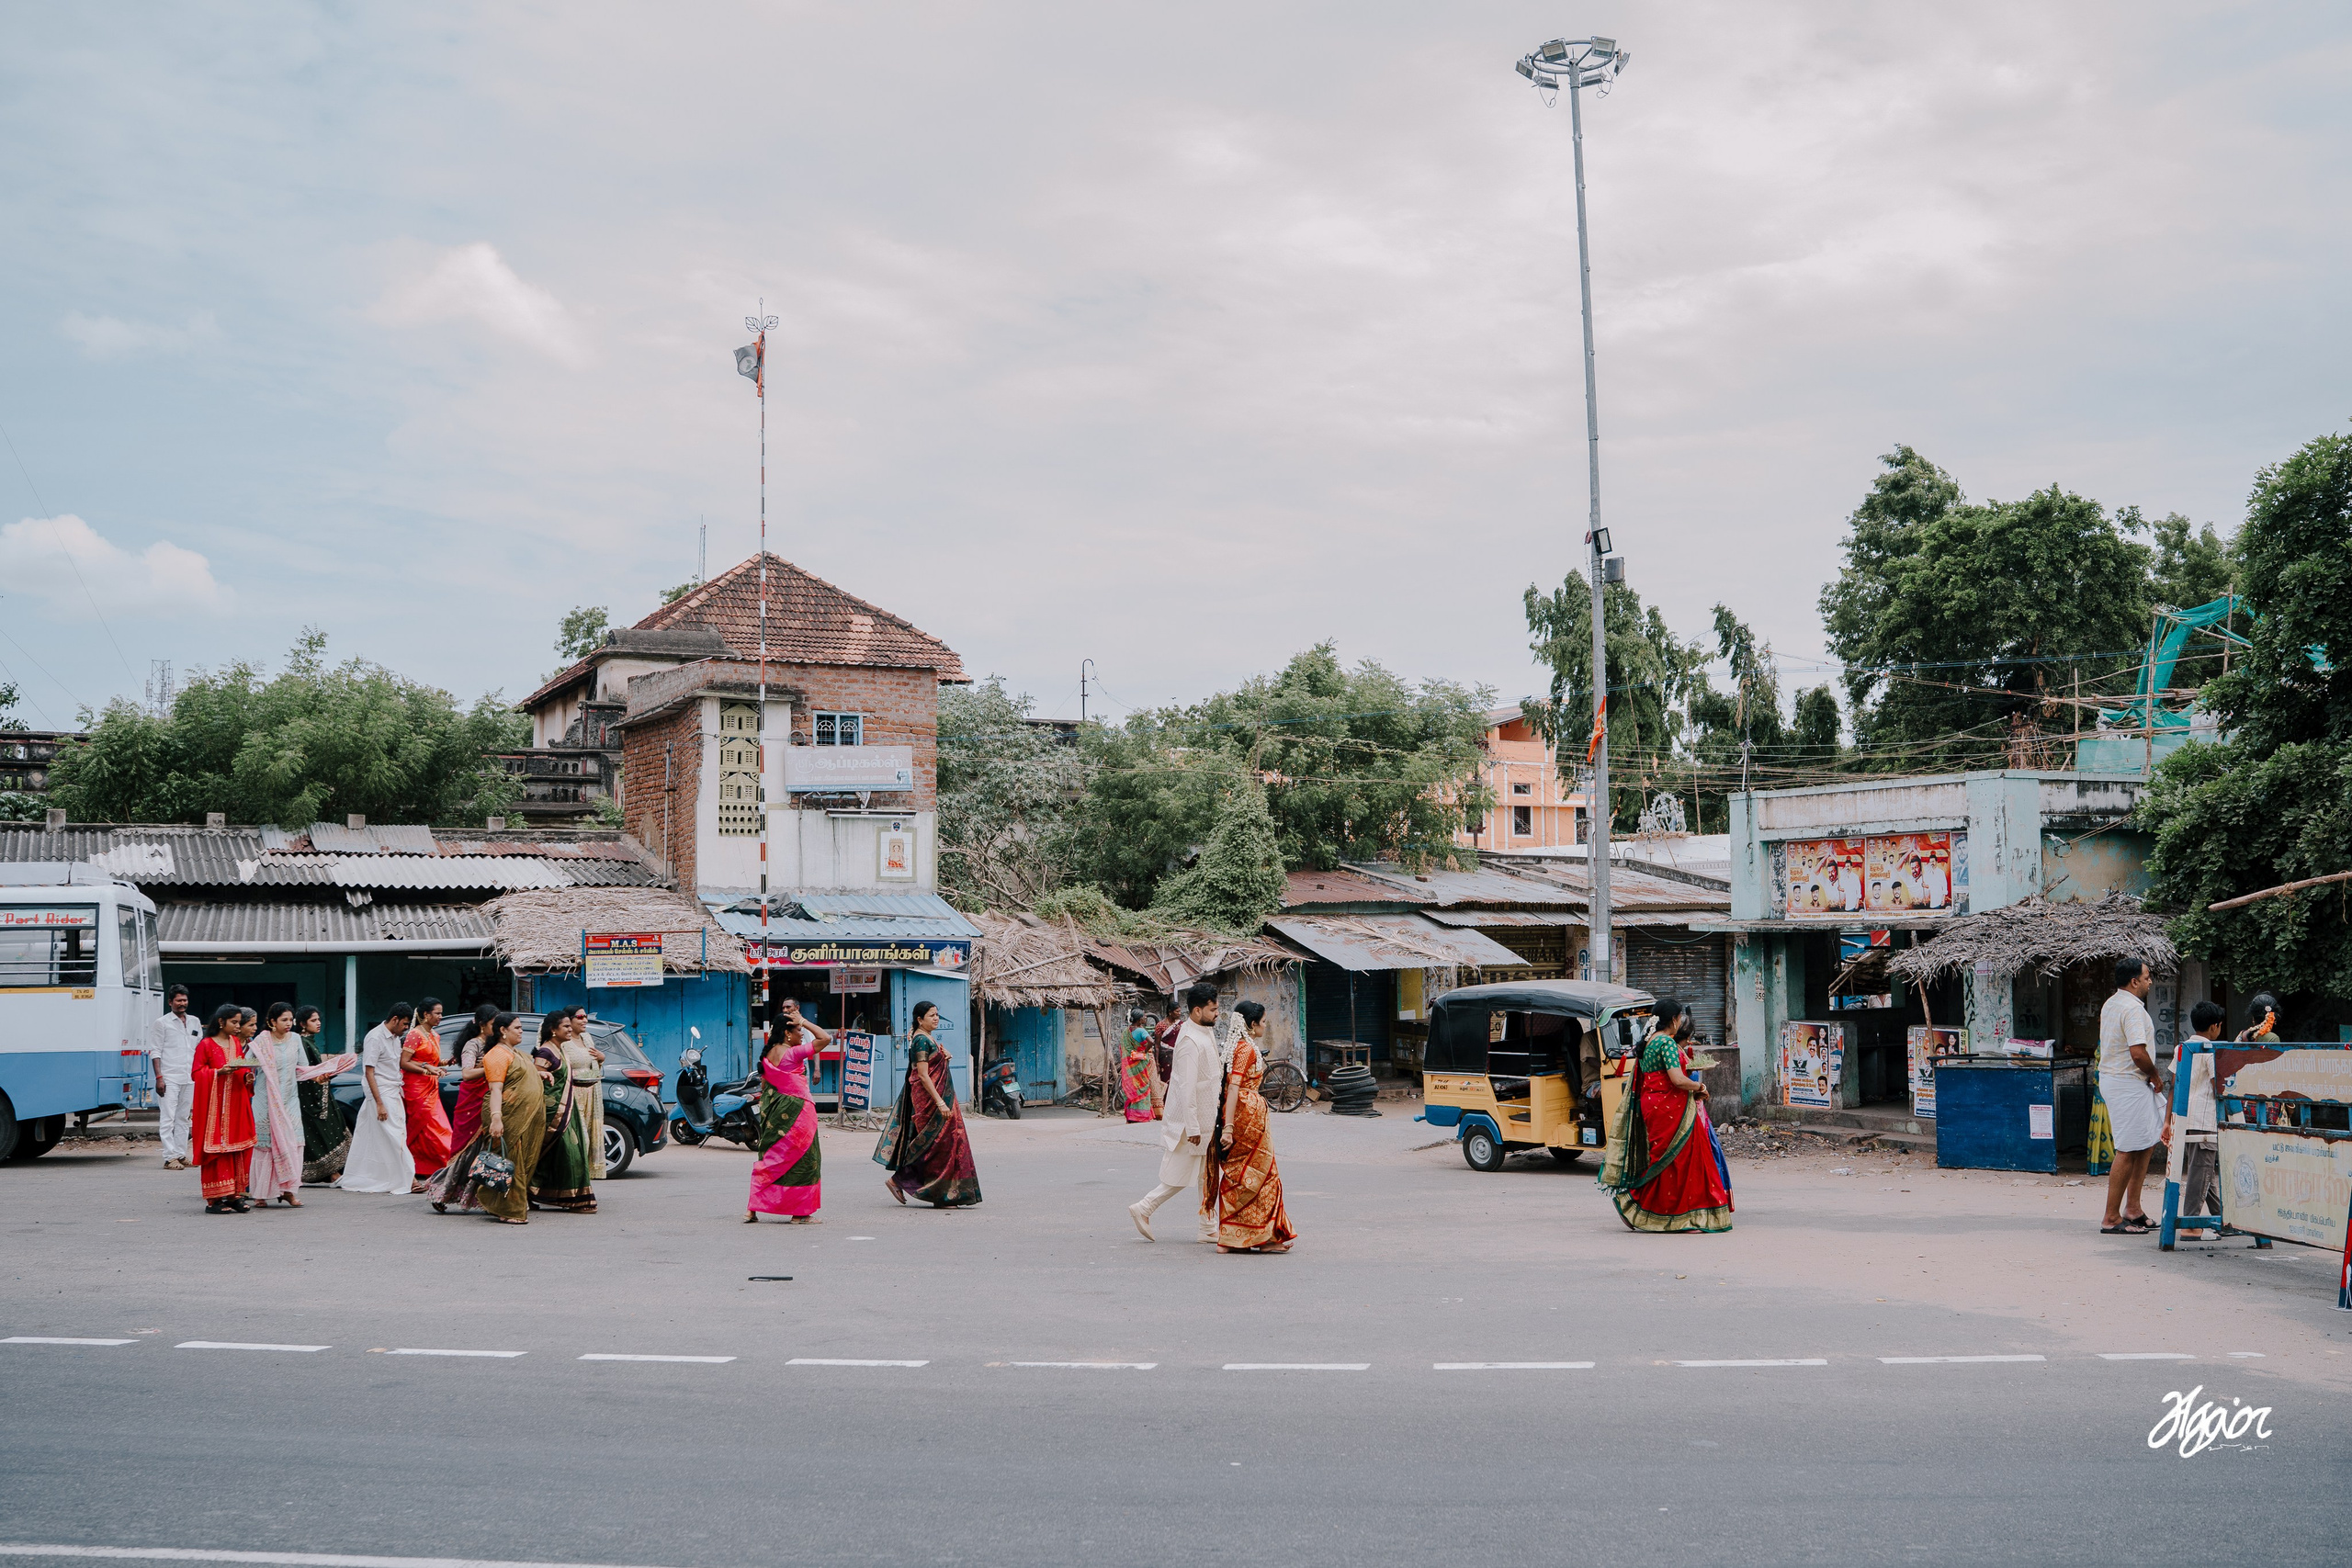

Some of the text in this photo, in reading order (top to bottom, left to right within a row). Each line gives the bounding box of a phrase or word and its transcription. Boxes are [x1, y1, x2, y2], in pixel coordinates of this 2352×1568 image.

[815, 754, 903, 771] ஆப்டிகல்ஸ்
[46, 913, 87, 924] Rider
[610, 940, 638, 948] M.A.S
[790, 942, 931, 963] குளிர்பானங்கள்
